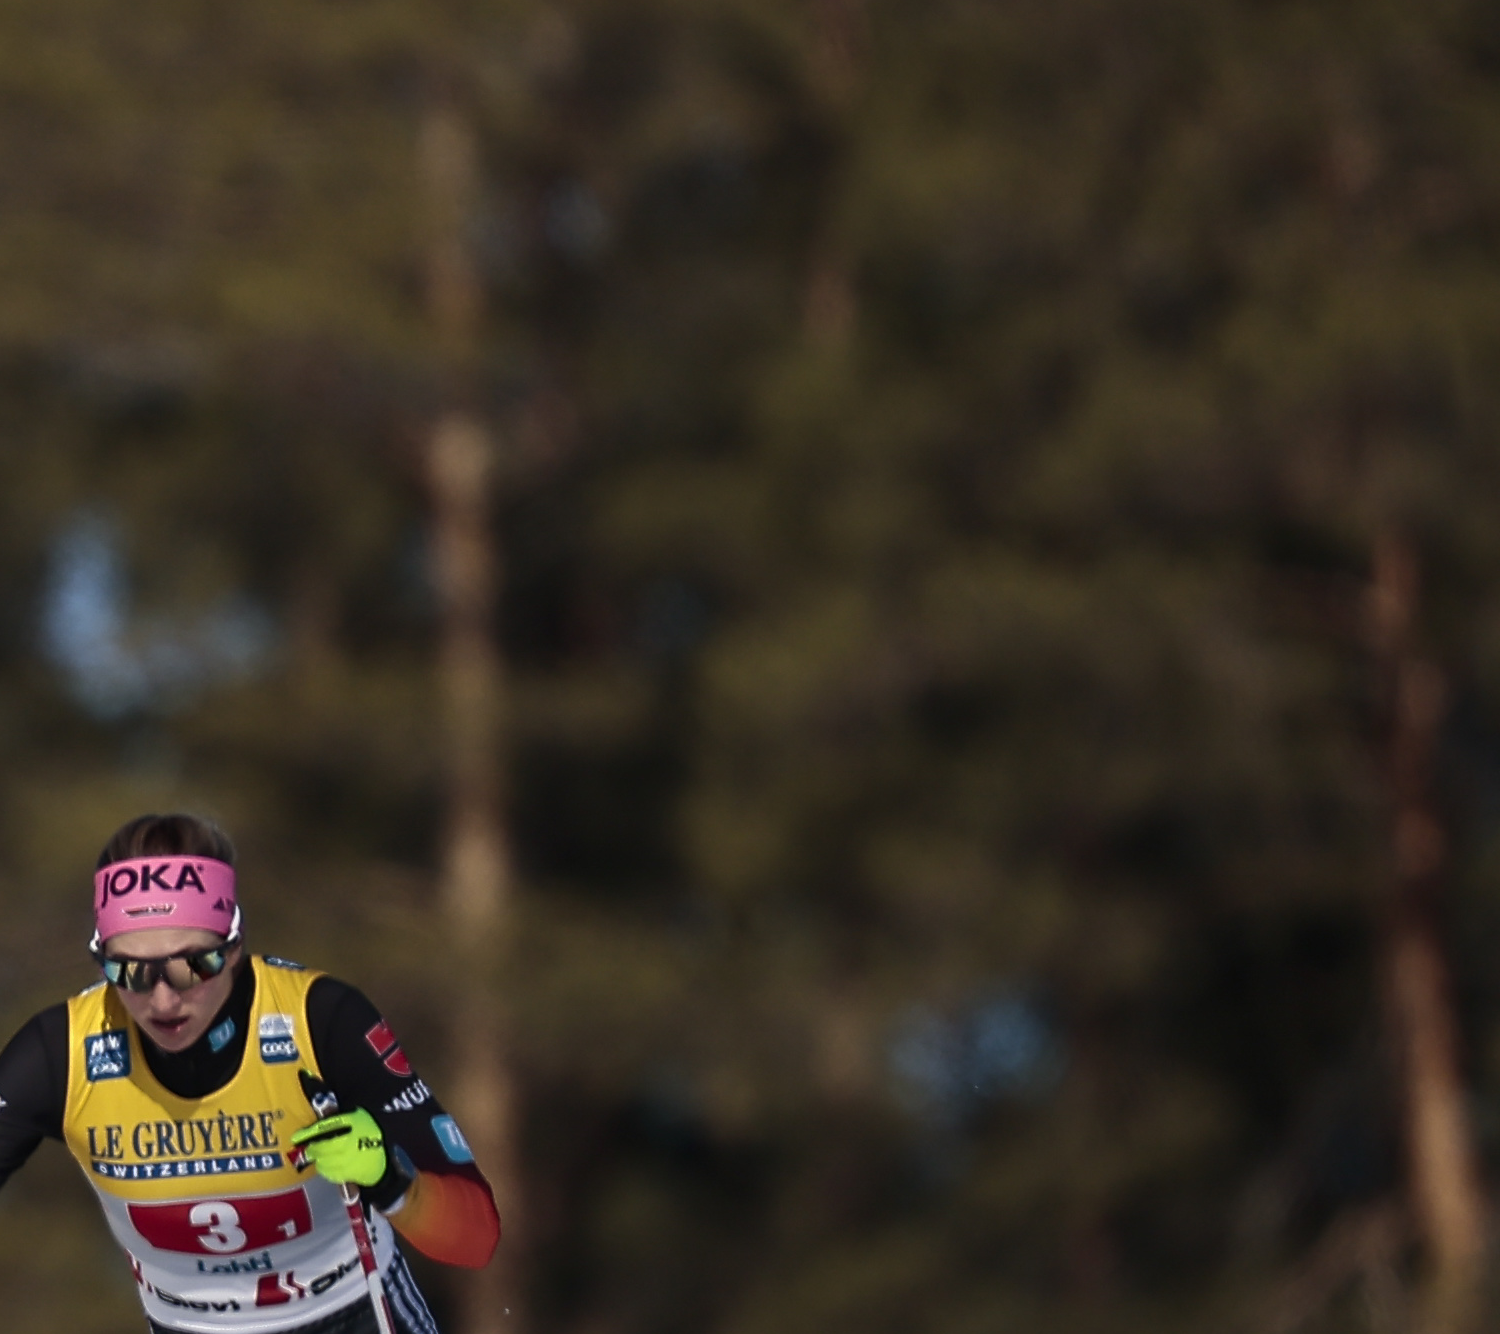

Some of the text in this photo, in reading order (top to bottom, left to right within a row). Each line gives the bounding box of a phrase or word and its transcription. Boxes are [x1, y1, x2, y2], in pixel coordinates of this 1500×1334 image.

[101, 862, 205, 909] JOKA
[88, 1124, 124, 1159] LE
[132, 1109, 279, 1158] GRUYÈRE
[189, 1200, 247, 1253] 3
[277, 1219, 297, 1239] 1
